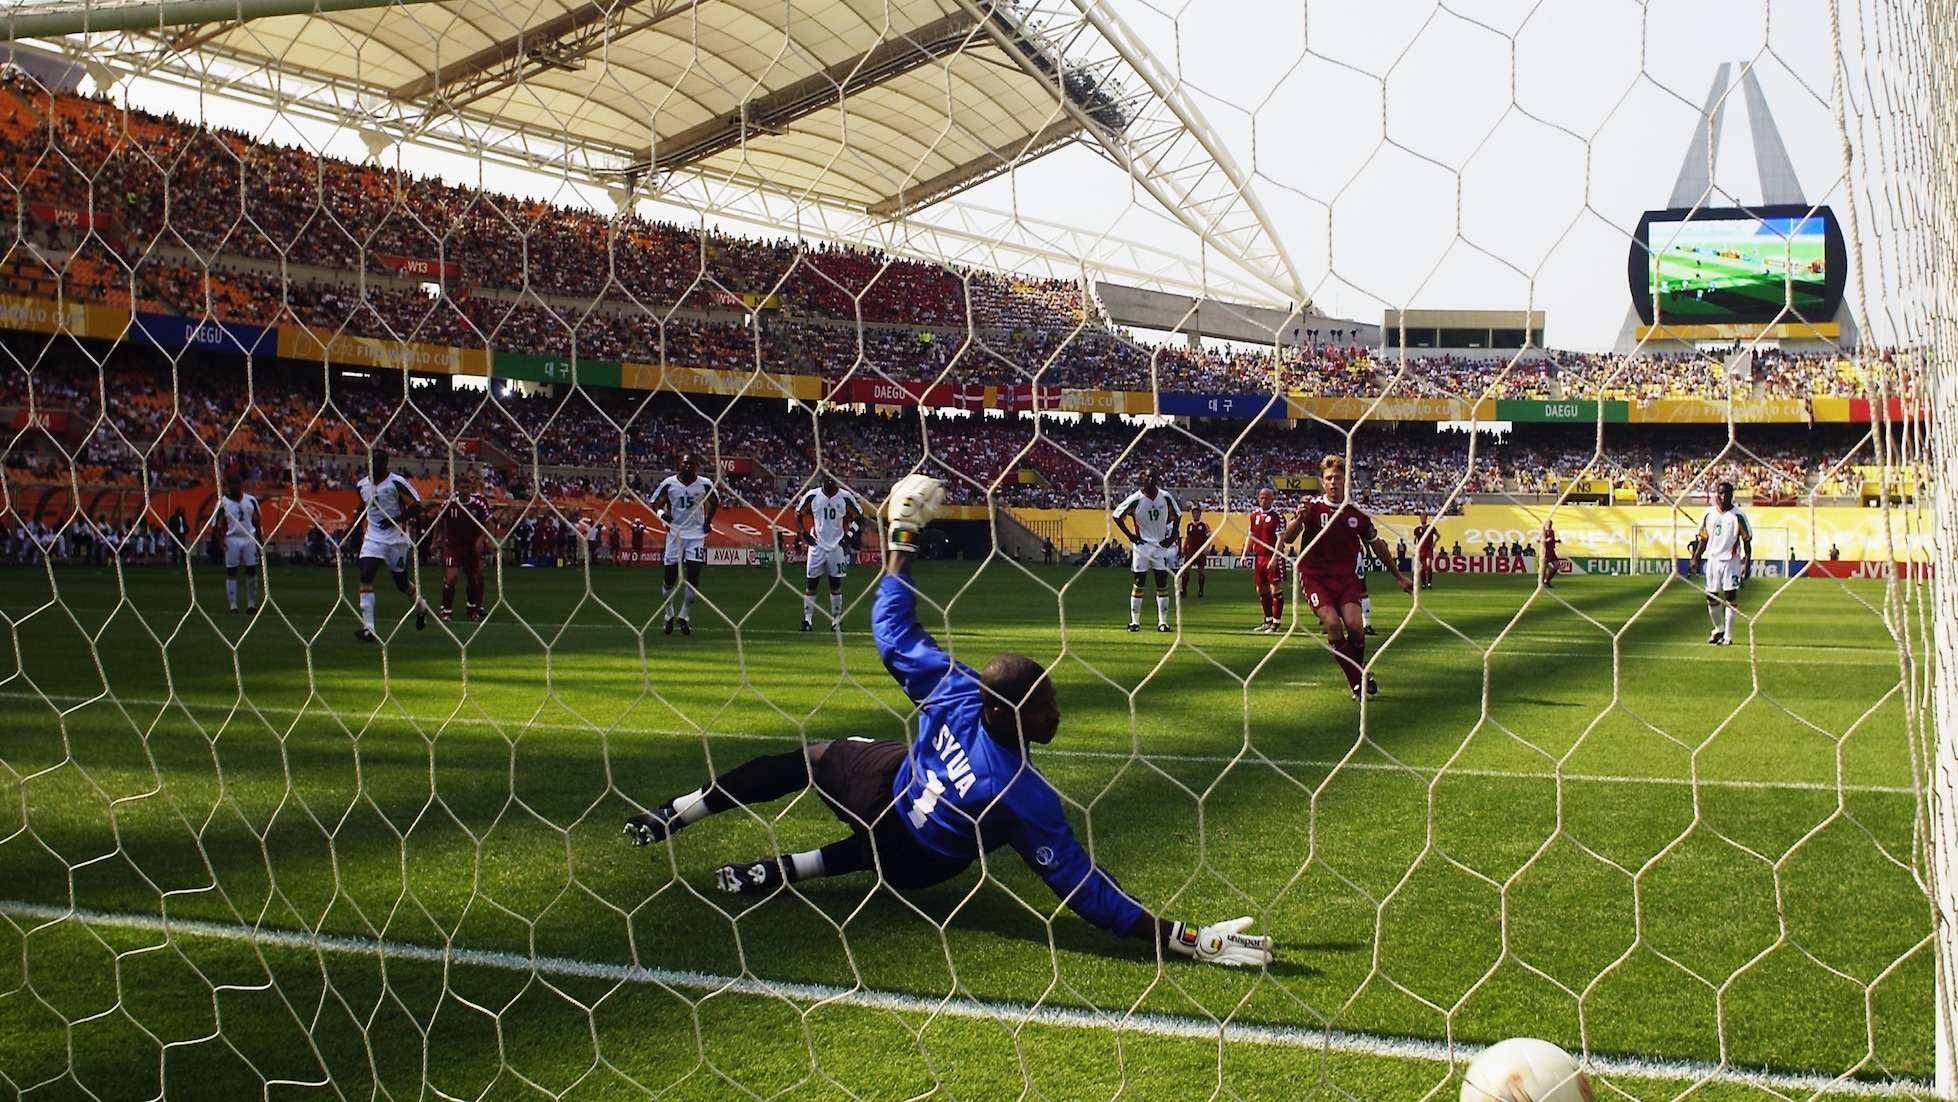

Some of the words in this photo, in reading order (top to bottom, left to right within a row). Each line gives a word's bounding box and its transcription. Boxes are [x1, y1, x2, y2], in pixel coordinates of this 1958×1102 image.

[407, 260, 428, 273] W13
[185, 324, 223, 344] DAEGU
[874, 384, 906, 400] DAEGU
[1545, 404, 1578, 418] DAEGU
[1286, 479, 1301, 489] N2
[1576, 483, 1592, 493] N3
[680, 496, 694, 509] 15
[450, 508, 458, 518] 11
[823, 507, 837, 520] 10
[1148, 509, 1160, 521] 19
[1320, 512, 1329, 528] 9
[1464, 528, 1542, 544] 2002
[1715, 524, 1722, 536] 3
[621, 551, 661, 561] McDnald's
[713, 550, 740, 566] AVAYA
[1430, 556, 1527, 573] OSHIBA
[1587, 559, 1671, 574] FUJIILM
[1311, 592, 1320, 607] 9
[907, 769, 946, 829] 1
